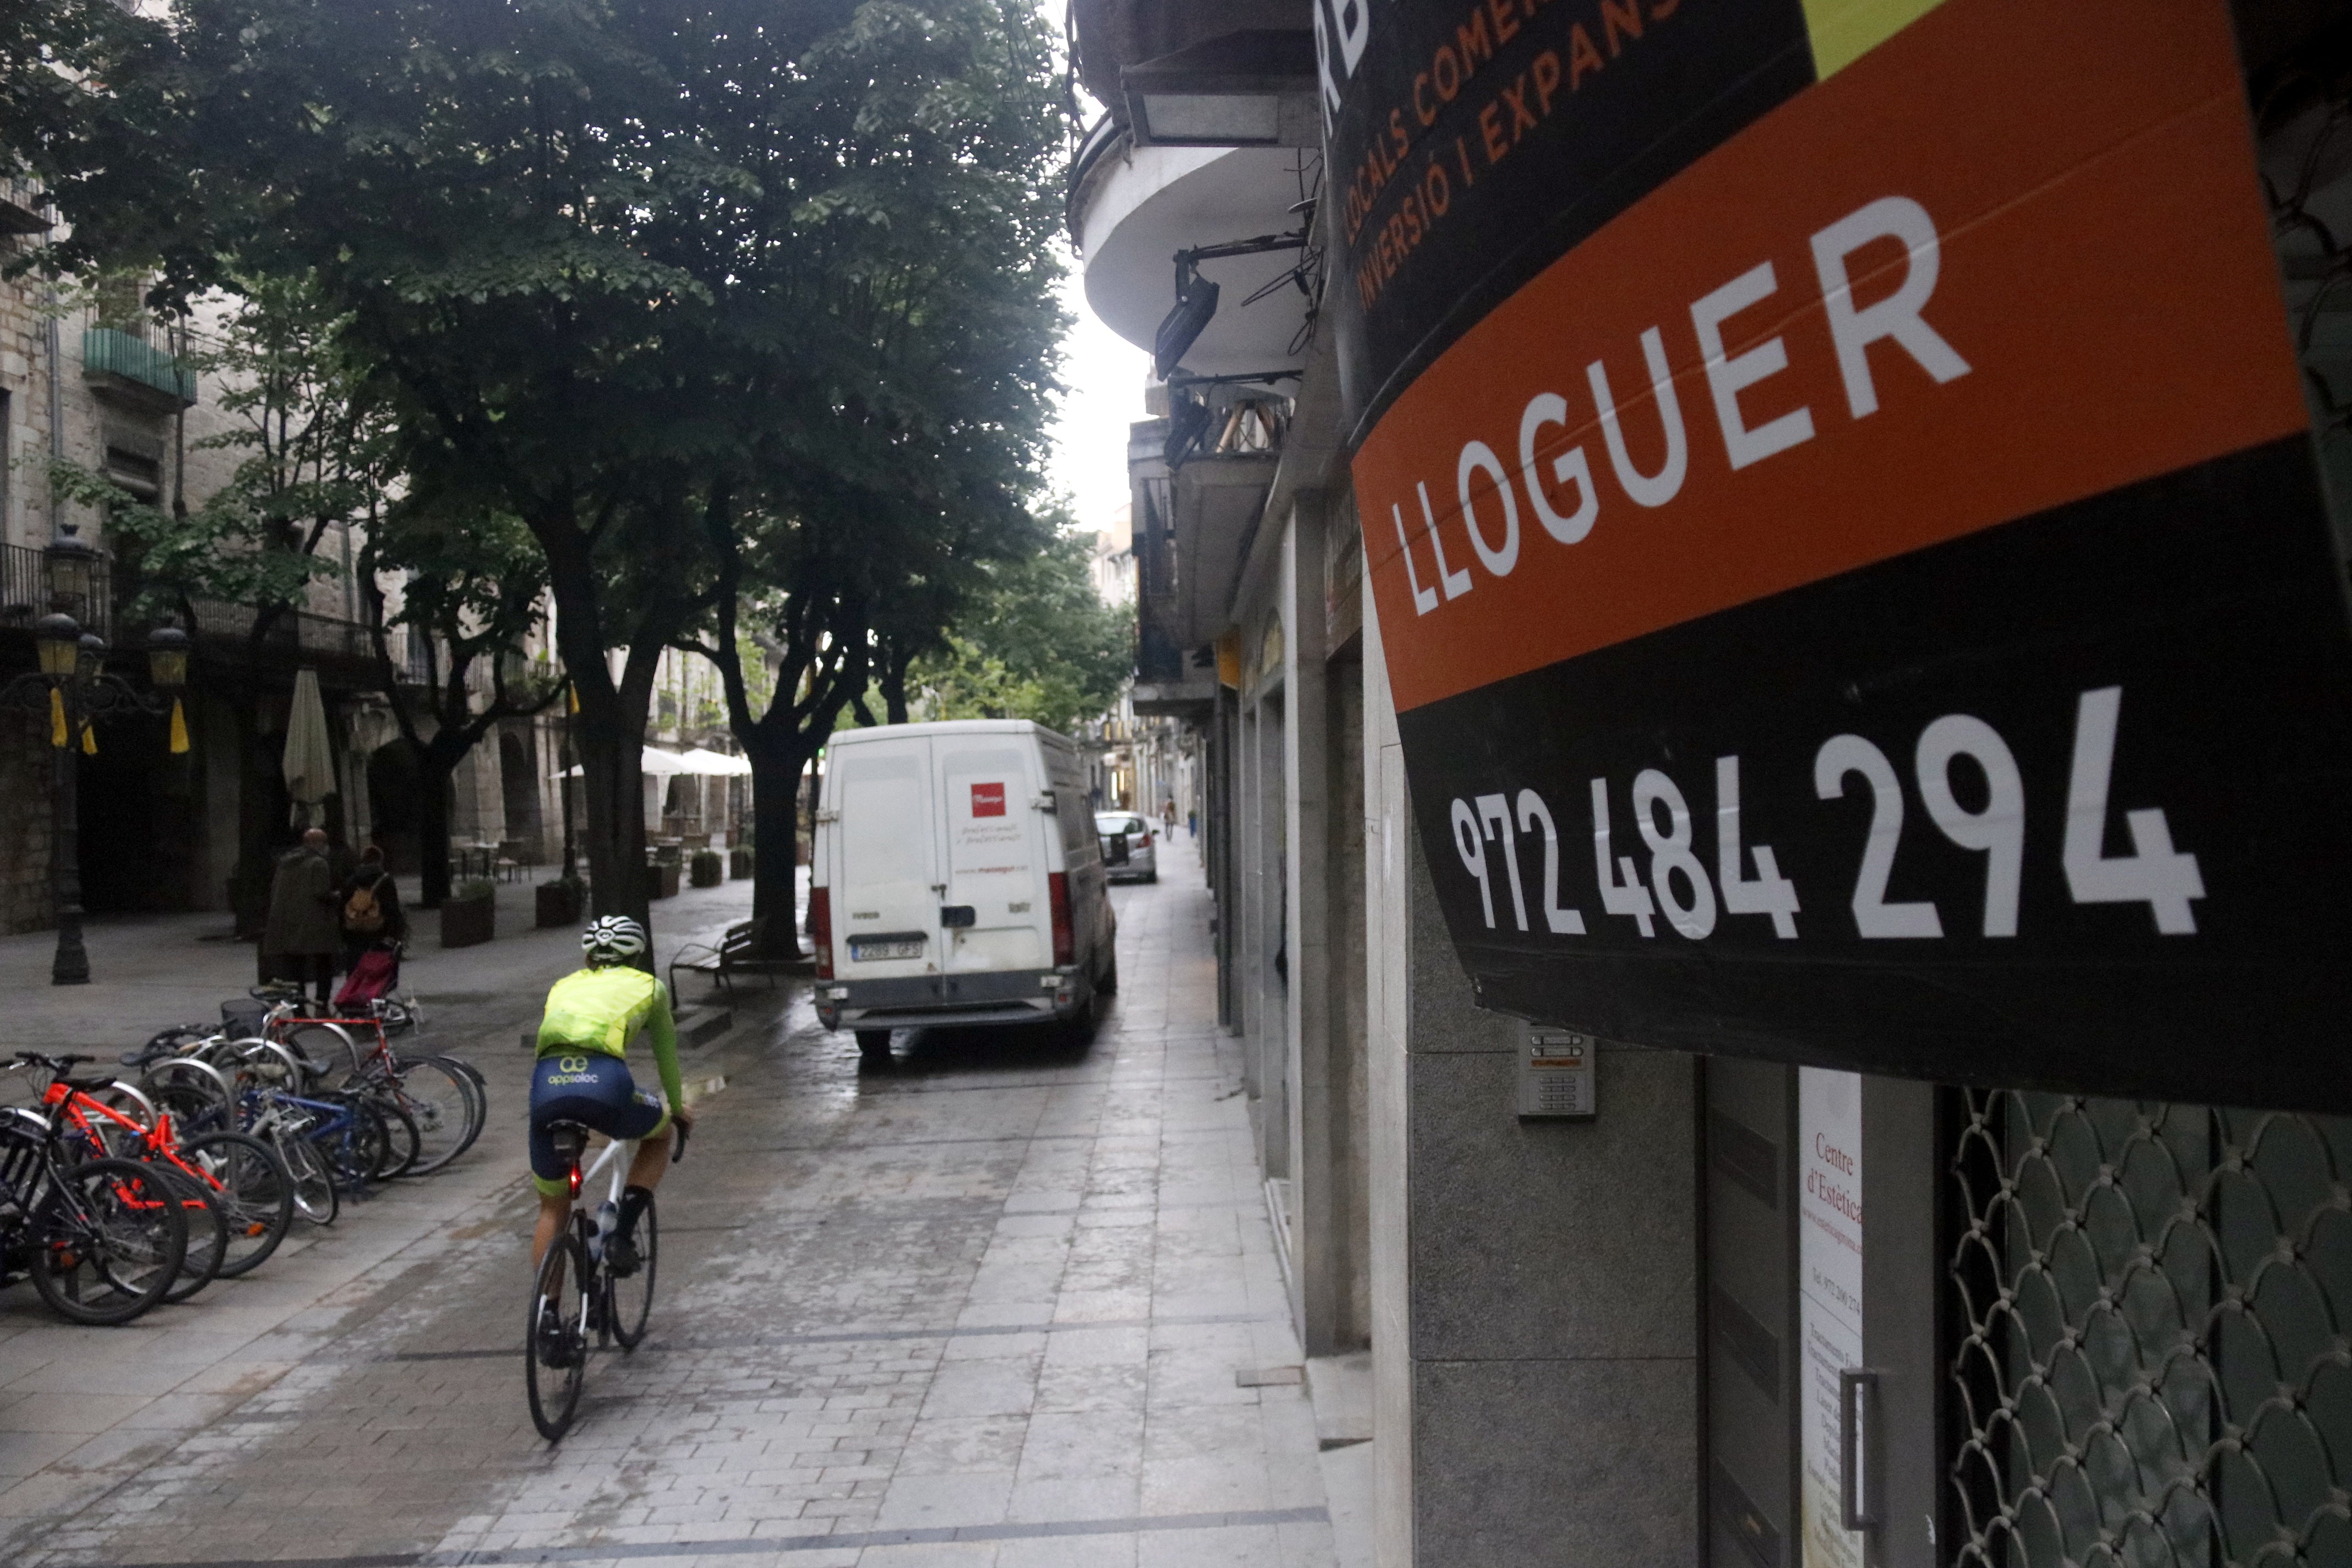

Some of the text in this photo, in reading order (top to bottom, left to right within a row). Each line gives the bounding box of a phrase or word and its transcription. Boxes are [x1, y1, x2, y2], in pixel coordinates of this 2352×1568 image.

[1344, 0, 1536, 247] LOCALS COME
[1457, 136, 1474, 188] I
[1391, 195, 1973, 617] LLOGUER
[1451, 685, 2207, 940] 972 484 294
[1816, 1132, 1854, 1177] Centre
